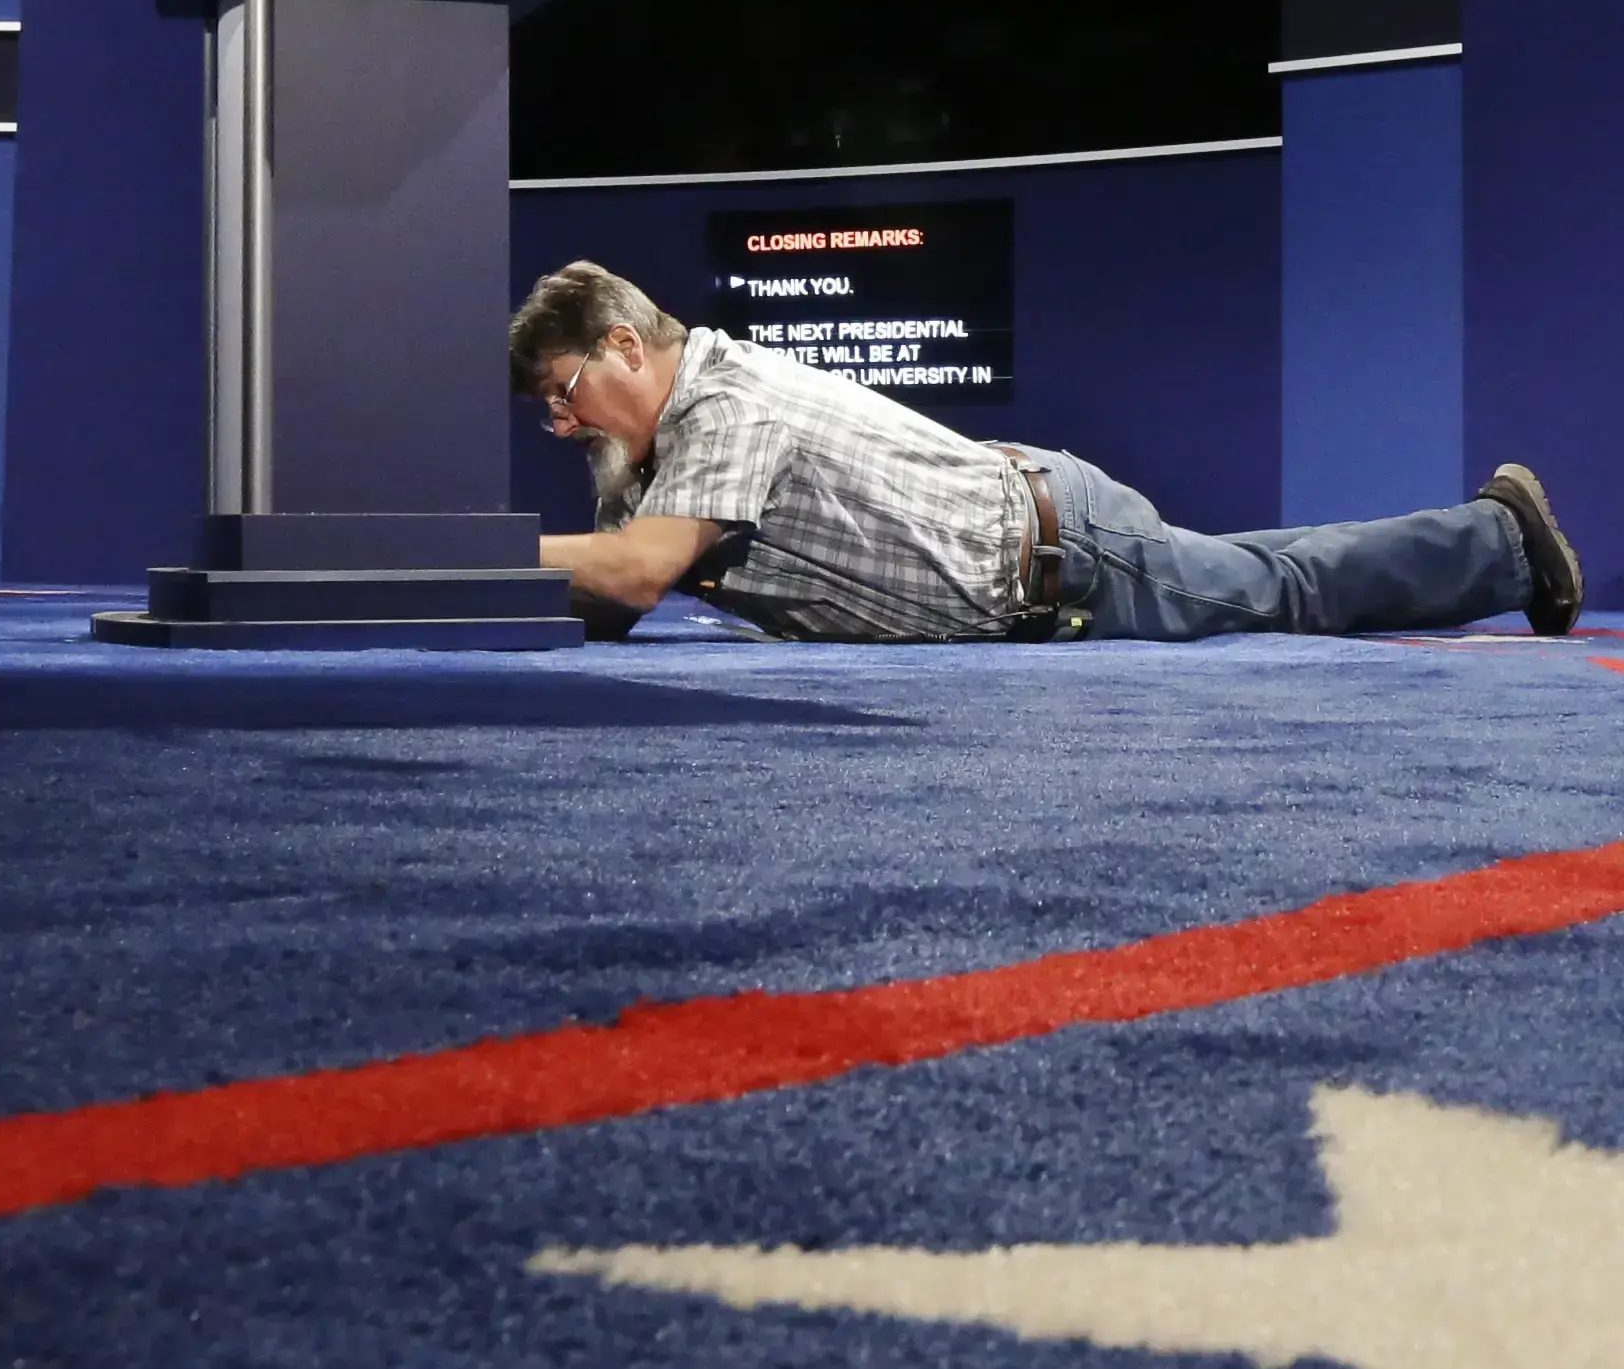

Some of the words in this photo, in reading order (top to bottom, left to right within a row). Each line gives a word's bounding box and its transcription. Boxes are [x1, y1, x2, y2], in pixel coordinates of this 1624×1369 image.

[747, 233, 826, 251] CLOSING
[830, 229, 924, 248] REMARKS:
[747, 279, 808, 297] THANK
[810, 277, 855, 295] YOU.
[748, 324, 783, 342] THE
[788, 323, 834, 341] NEXT
[839, 320, 968, 340] PRESIDENTIAL
[822, 346, 865, 363] WILL
[869, 345, 894, 362] BE
[897, 344, 921, 361] AT
[860, 367, 968, 385] UNIVERSITY
[972, 367, 992, 383] IN
